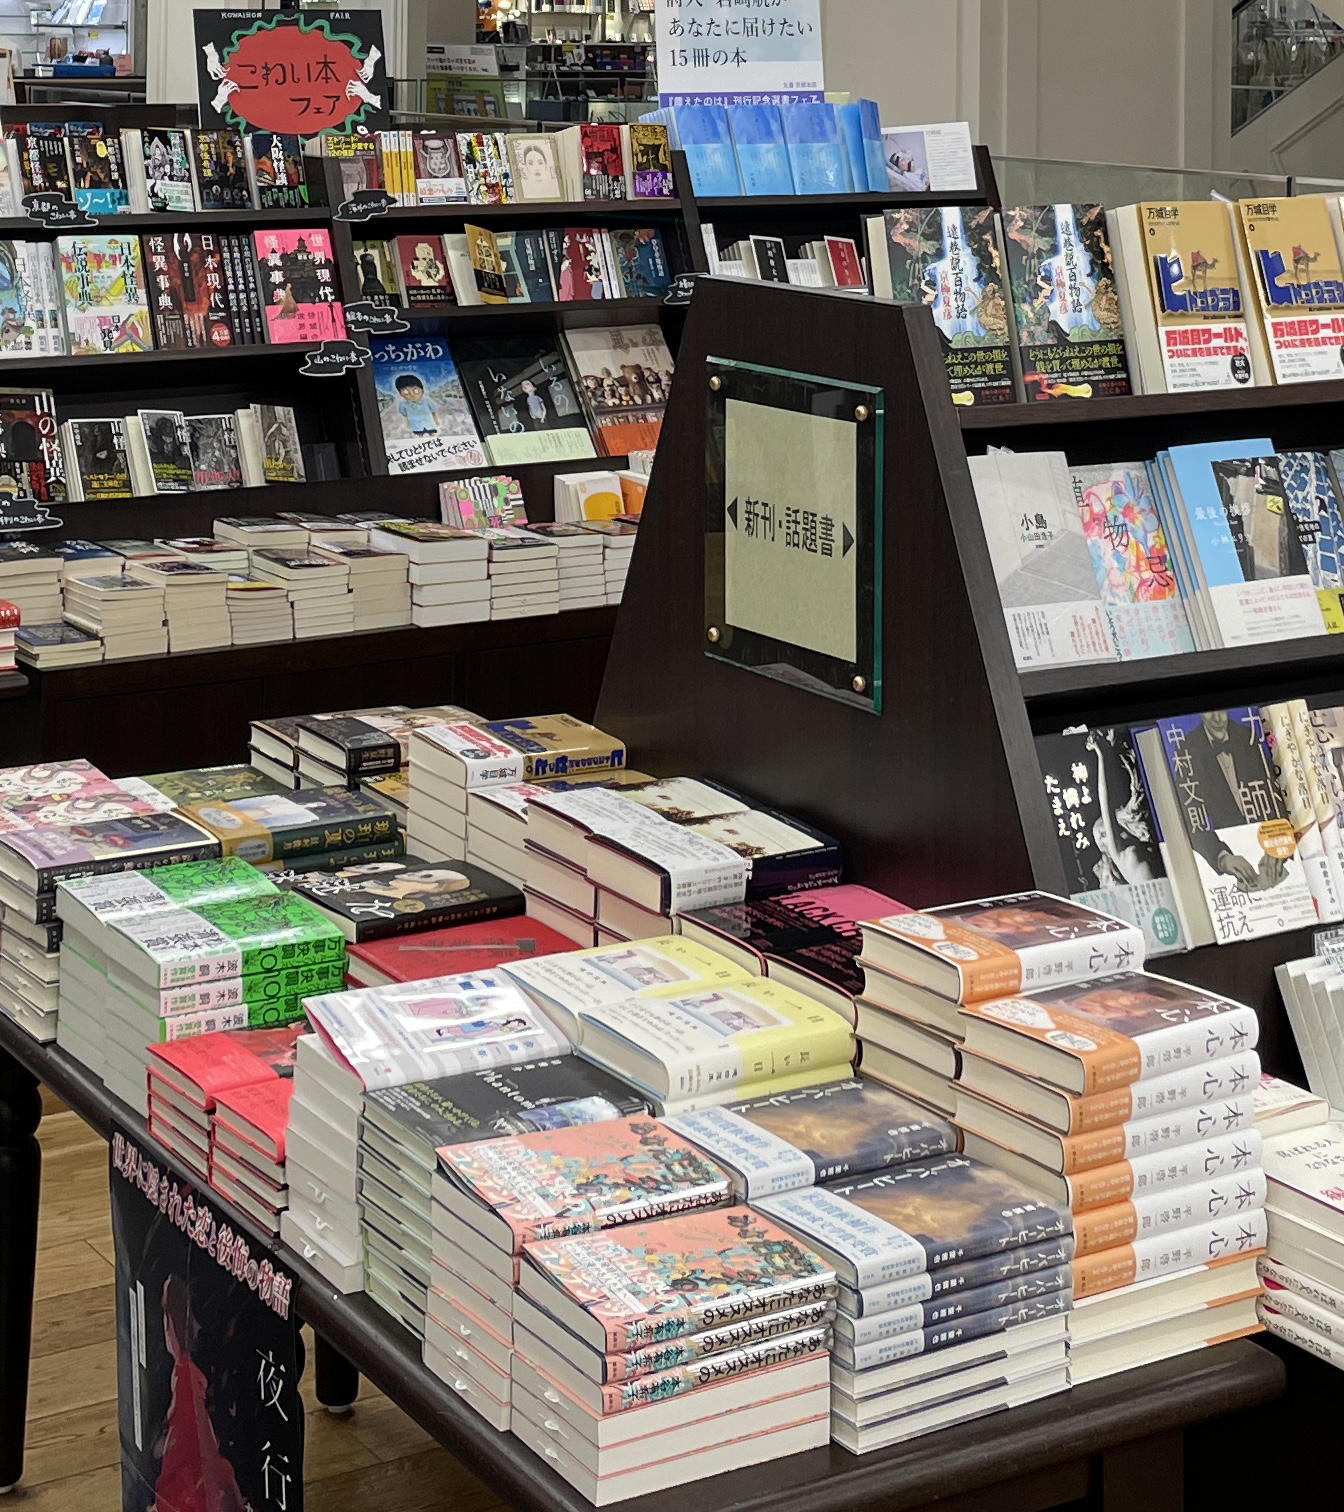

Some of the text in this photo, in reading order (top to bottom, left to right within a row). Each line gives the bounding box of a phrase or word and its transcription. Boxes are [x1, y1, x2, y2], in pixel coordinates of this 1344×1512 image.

[668, 17, 814, 38] あなたに届けたい
[236, 55, 342, 89] こわい本
[669, 48, 748, 68] 15冊の本
[288, 93, 343, 117] フェア
[370, 342, 444, 363] っちがわ
[743, 495, 836, 558] 新刊・話題書
[1020, 512, 1048, 531] 小島
[1166, 725, 1211, 834] 中村文則
[1239, 780, 1273, 823] 師
[1210, 883, 1262, 914] 運命に
[1218, 911, 1255, 939] 抗え
[1087, 940, 1135, 975] 本心
[1203, 1019, 1250, 1058] 本心
[1201, 1062, 1251, 1101] 本心
[1195, 1098, 1245, 1137] 本心
[1202, 1141, 1254, 1176] 本心
[1207, 1180, 1257, 1218] 本心
[1207, 1219, 1258, 1259] 本心
